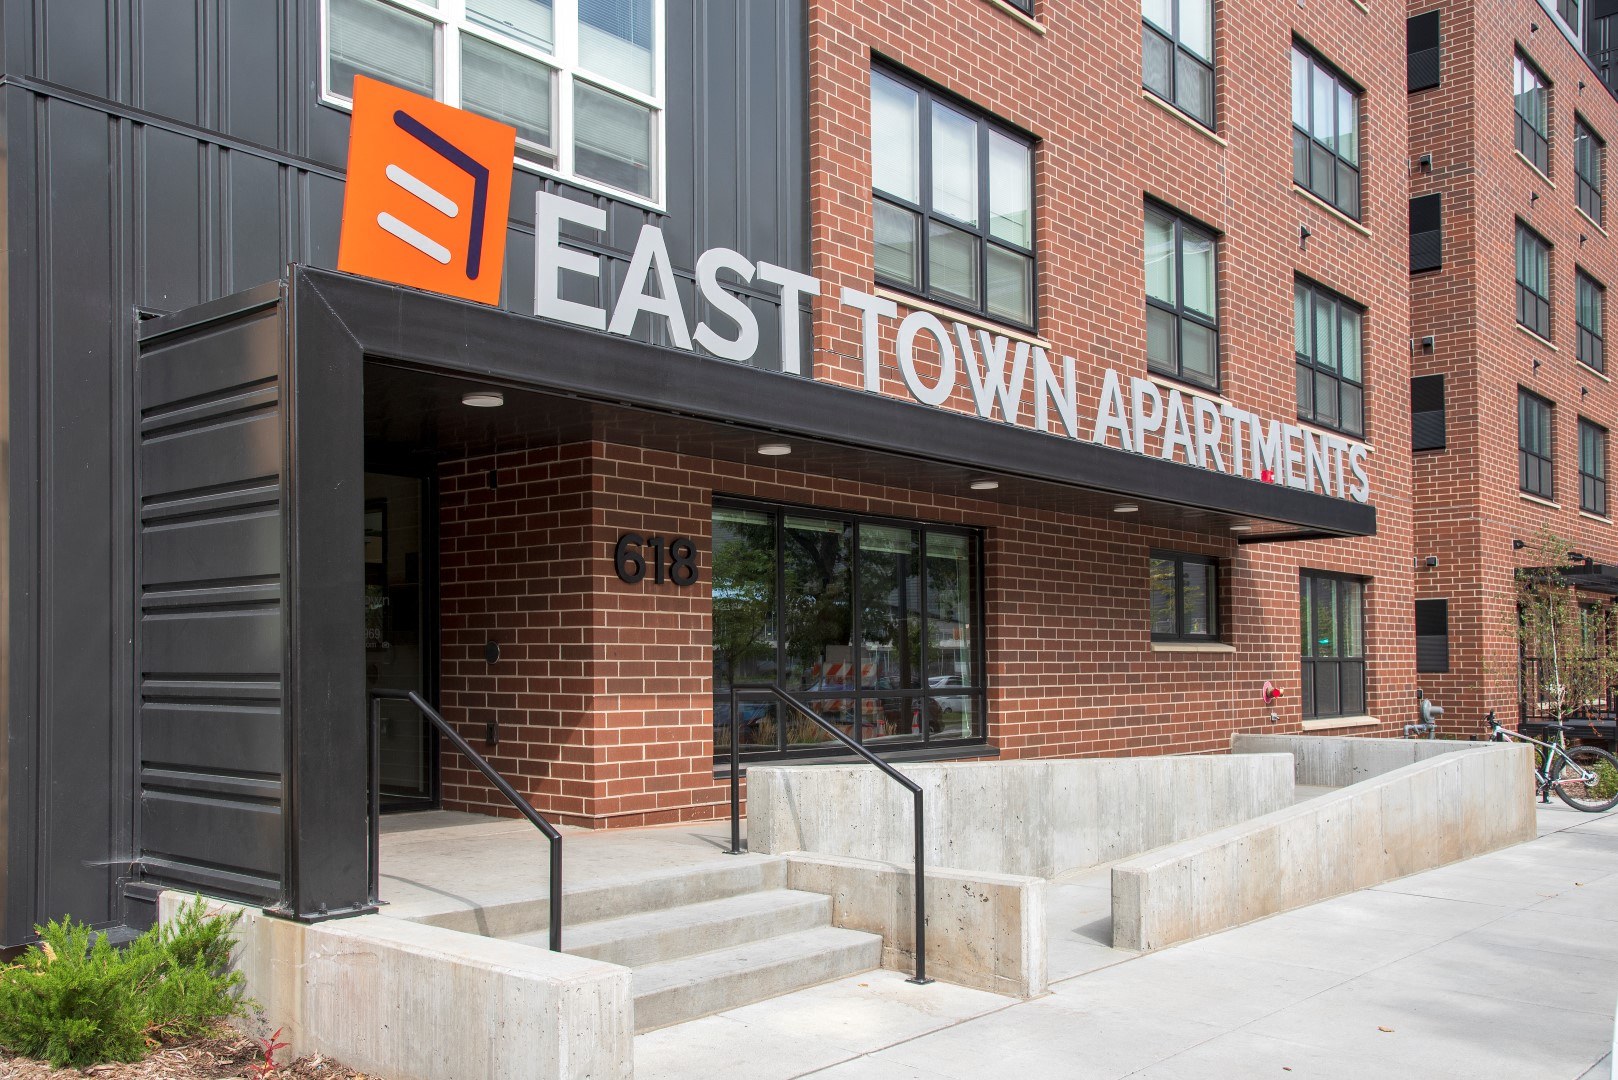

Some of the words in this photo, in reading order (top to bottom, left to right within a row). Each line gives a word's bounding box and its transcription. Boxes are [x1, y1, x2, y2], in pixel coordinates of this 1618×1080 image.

[534, 191, 820, 374] EAST
[840, 287, 1078, 439] TOWN
[1093, 368, 1370, 503] APARTMENTS
[614, 533, 699, 586] 618
